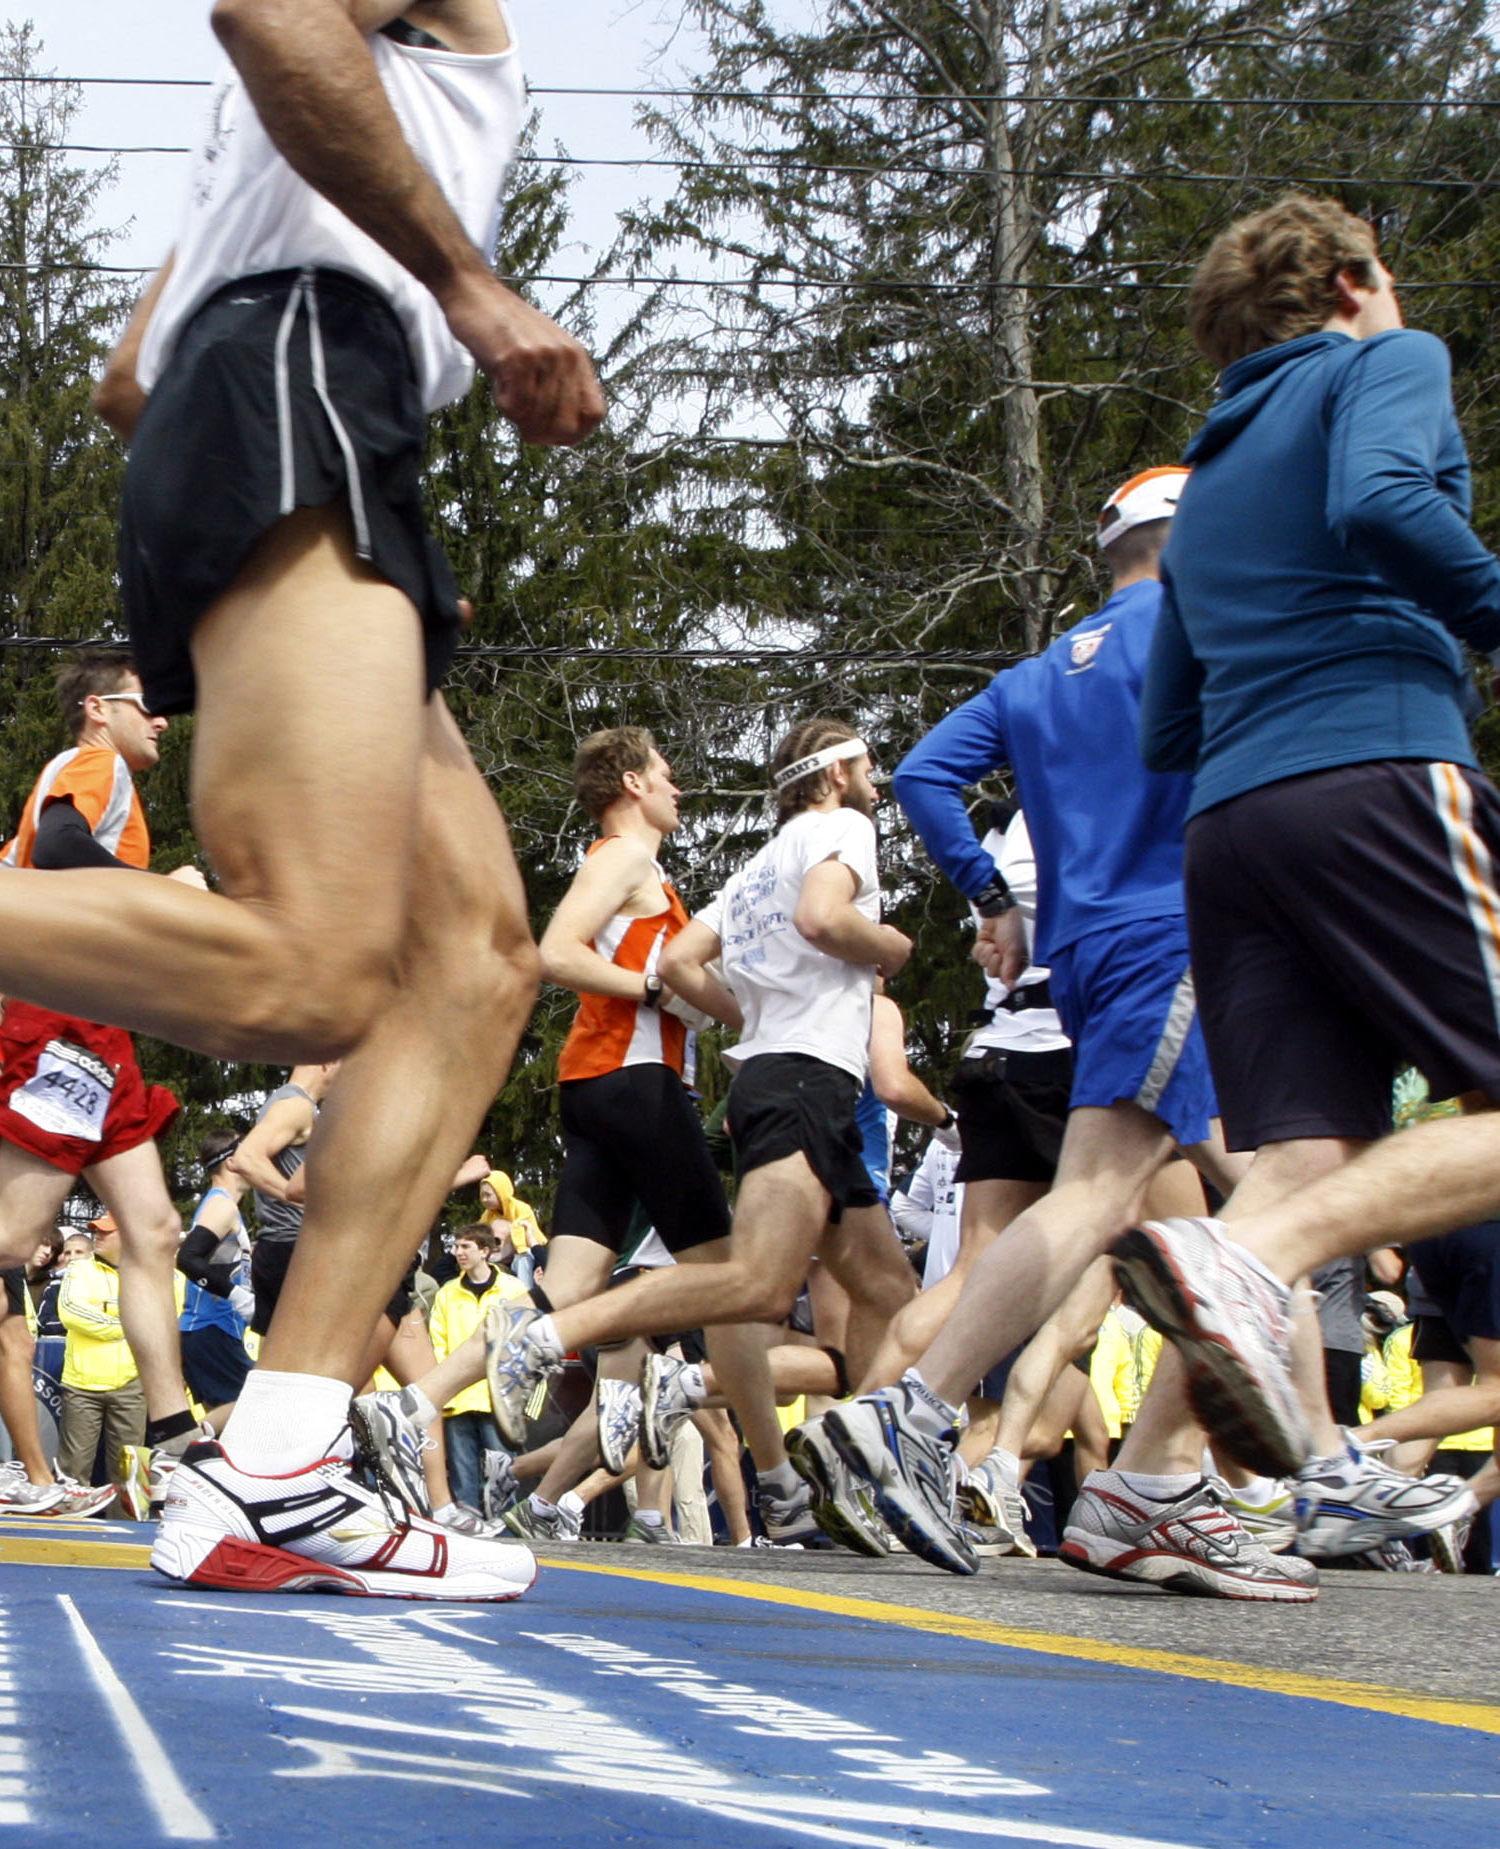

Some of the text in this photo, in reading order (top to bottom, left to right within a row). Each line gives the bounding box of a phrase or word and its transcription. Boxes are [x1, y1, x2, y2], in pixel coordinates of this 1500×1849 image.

[155, 1600, 582, 1712] Hancock
[519, 1632, 1054, 1798] the future is yours
